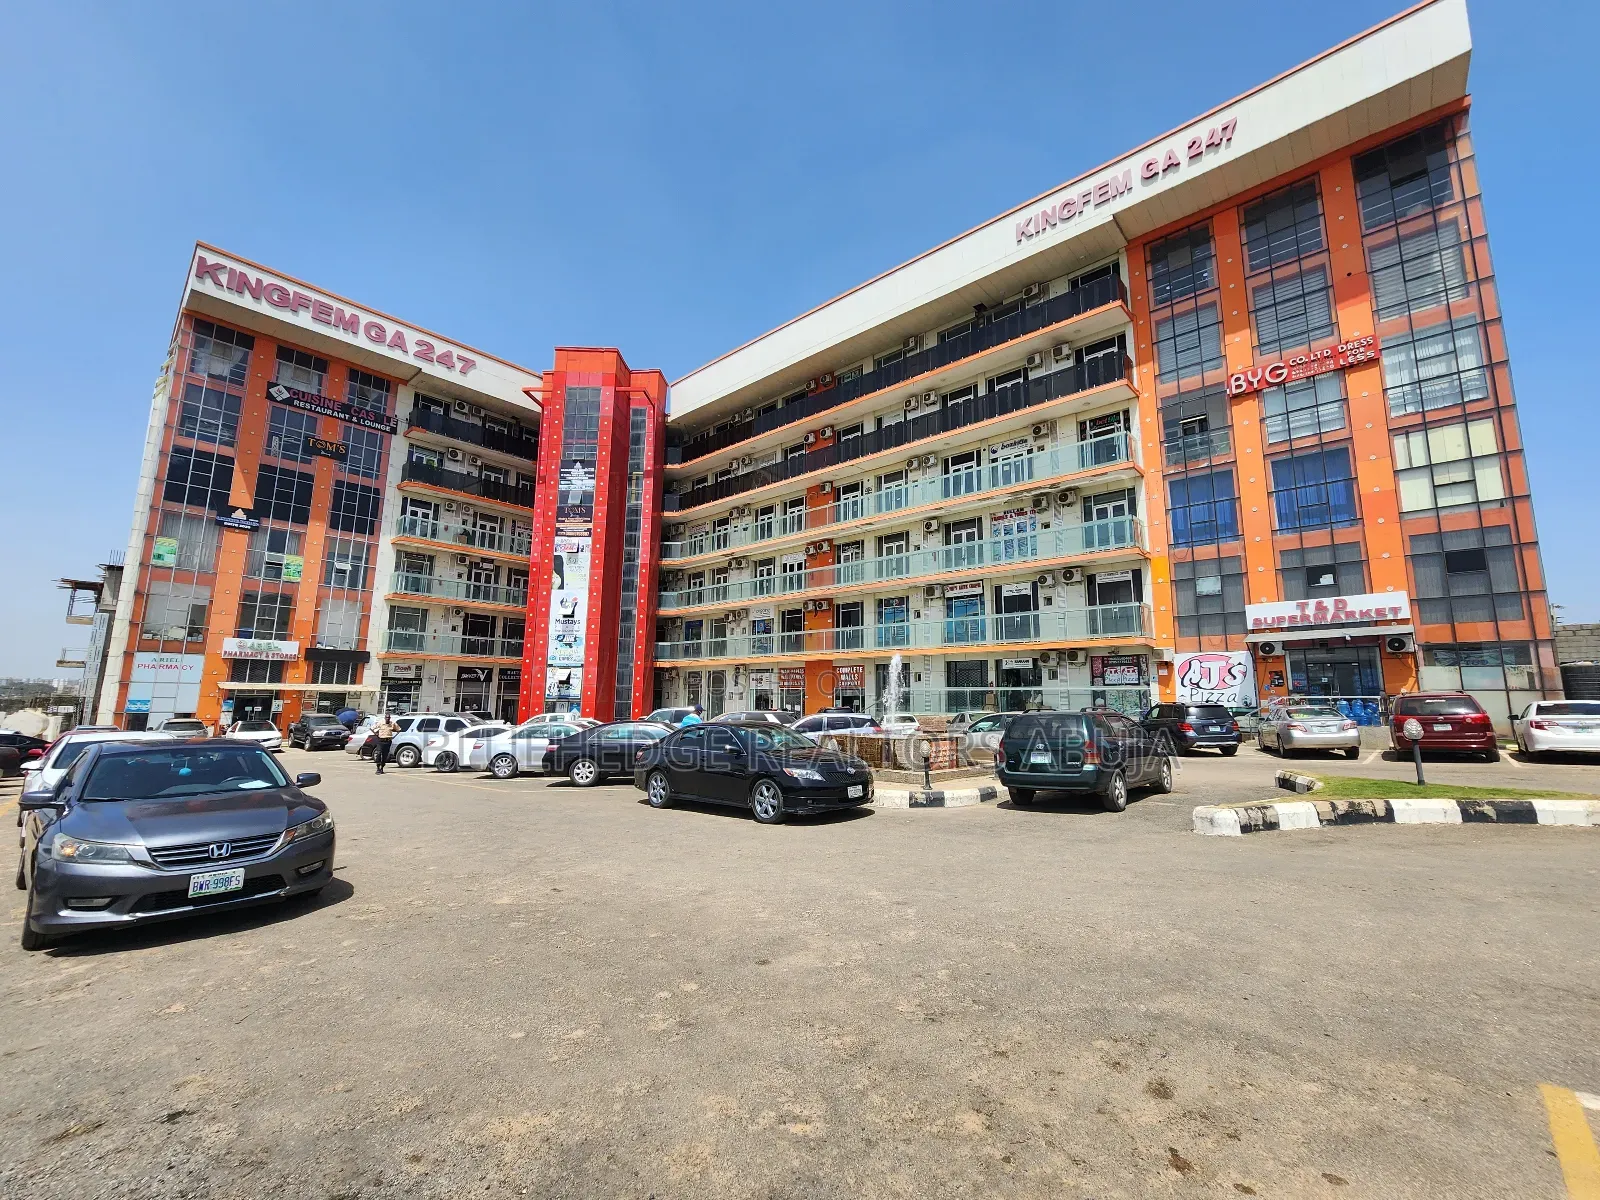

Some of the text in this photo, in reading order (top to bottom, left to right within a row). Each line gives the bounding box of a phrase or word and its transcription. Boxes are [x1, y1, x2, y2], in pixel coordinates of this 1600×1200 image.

[1016, 116, 1237, 246] KINGFEM GA 247
[195, 255, 476, 374] KINGFEM GA 247
[1337, 336, 1374, 353] DRESS
[1347, 346, 1366, 357] FOR
[1339, 350, 1375, 366] LESS
[1231, 362, 1289, 395] BYG
[289, 388, 342, 411] CUISINE
[293, 399, 350, 420] RESTAURANT
[360, 419, 391, 432] LOUNGE
[1296, 598, 1348, 613] T & D
[1252, 606, 1402, 627] SUPERMARKET
[223, 650, 263, 659] PHARMACY
[137, 663, 195, 671] PHARMACY
